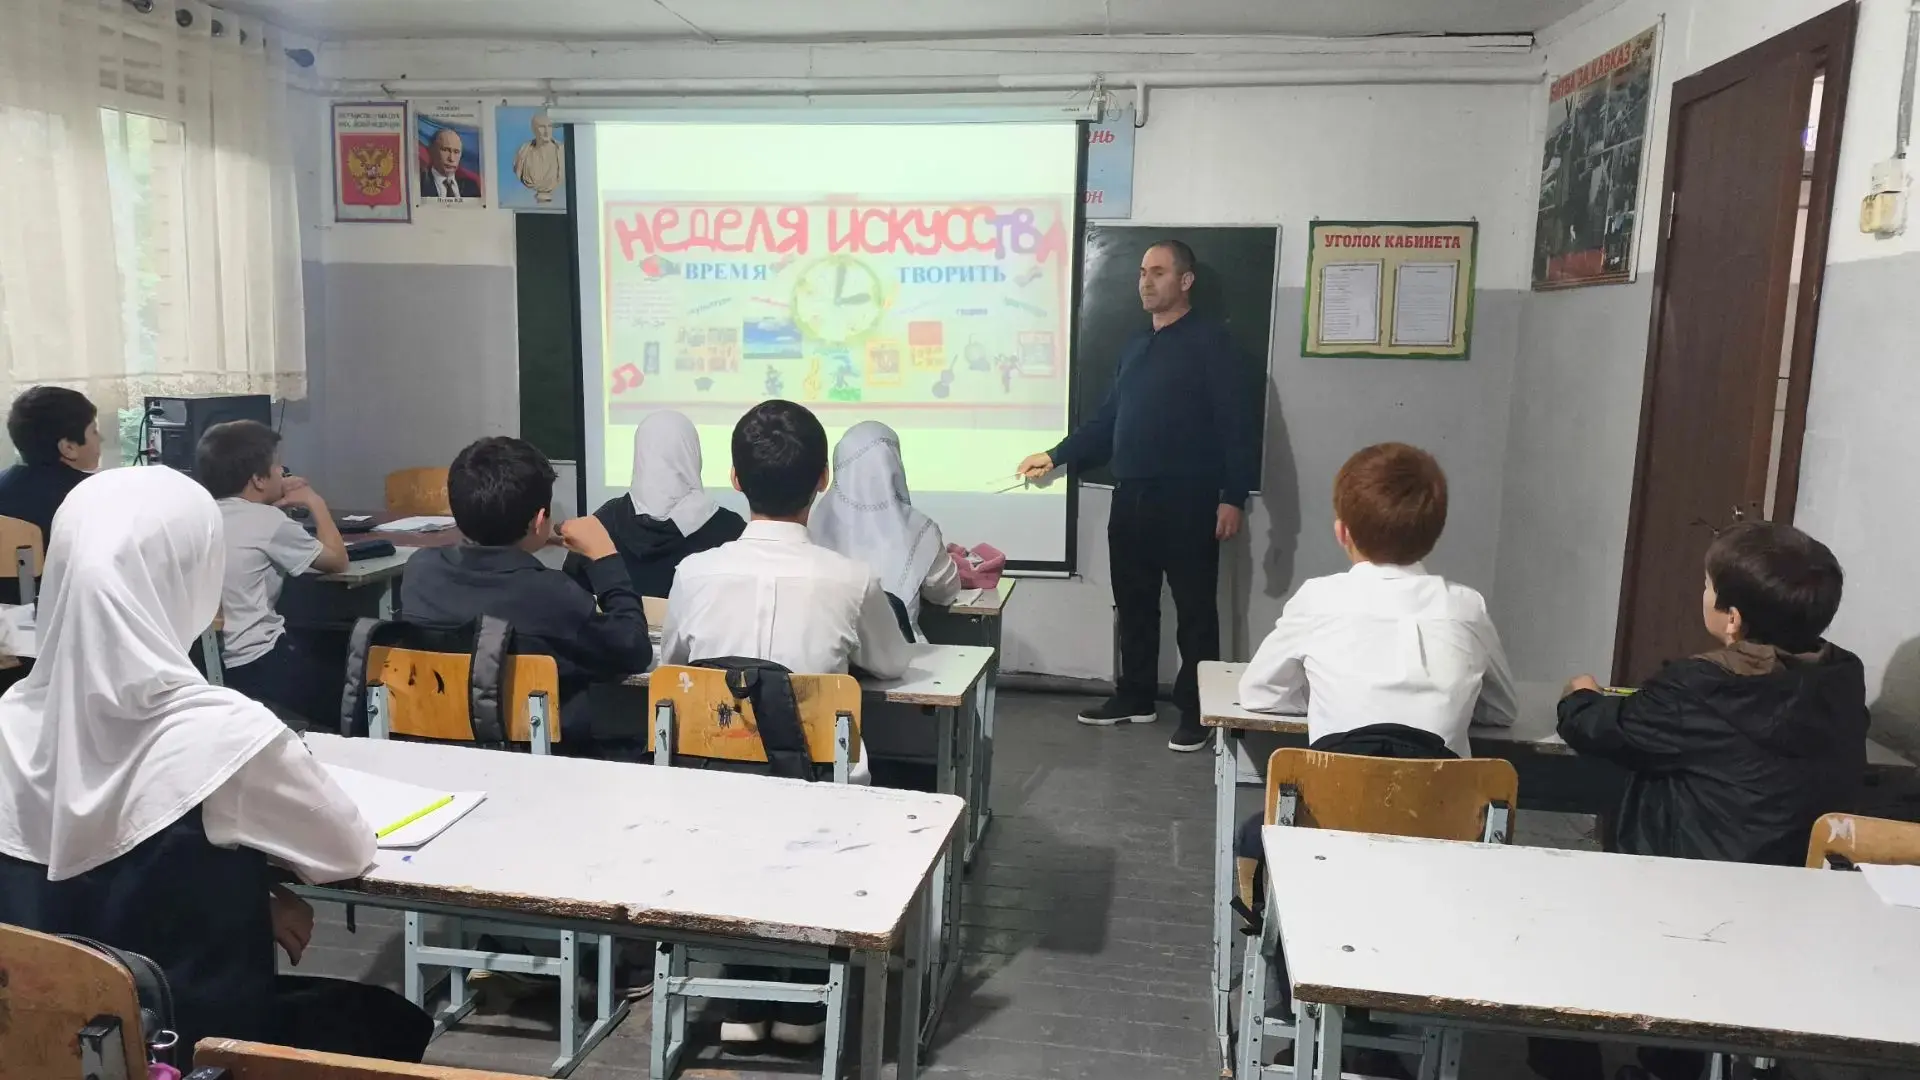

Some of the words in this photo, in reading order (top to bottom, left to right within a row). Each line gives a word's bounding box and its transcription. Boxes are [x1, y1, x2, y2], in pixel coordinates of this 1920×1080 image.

[1324, 234, 1382, 248] УГОЛОК
[1384, 235, 1461, 249] КАБИНЕТА
[685, 262, 768, 281] ВРЕМЯ
[897, 265, 1007, 284] ТВОРИТЬ
